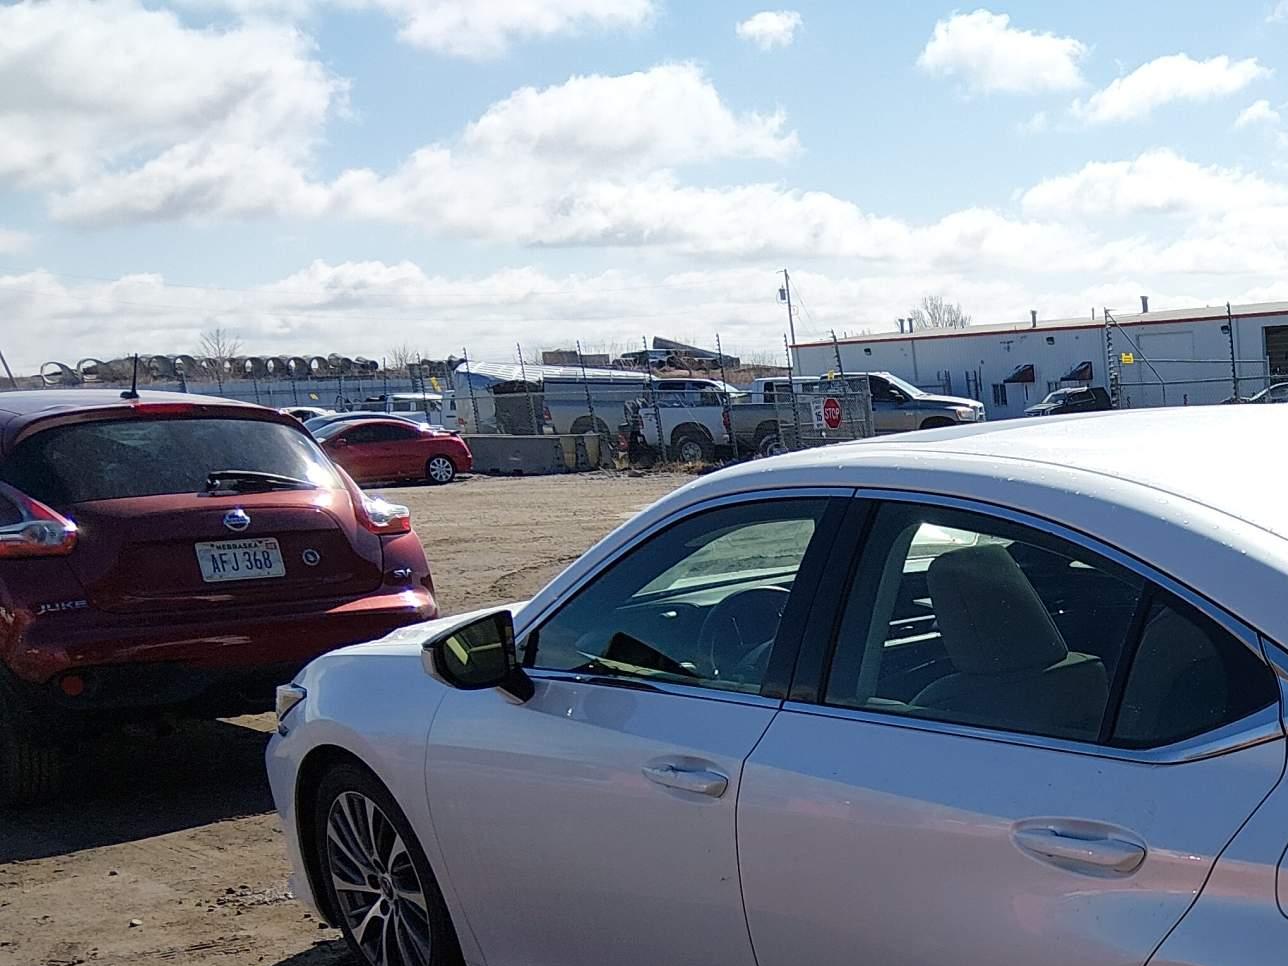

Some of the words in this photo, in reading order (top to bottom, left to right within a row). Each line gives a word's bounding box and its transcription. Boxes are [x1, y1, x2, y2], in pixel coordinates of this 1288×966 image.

[824, 408, 840, 419] STOP
[215, 542, 259, 551] NEBRASKA
[211, 552, 240, 573] AFJ
[243, 550, 273, 570] 368
[36, 600, 88, 616] JUKE
